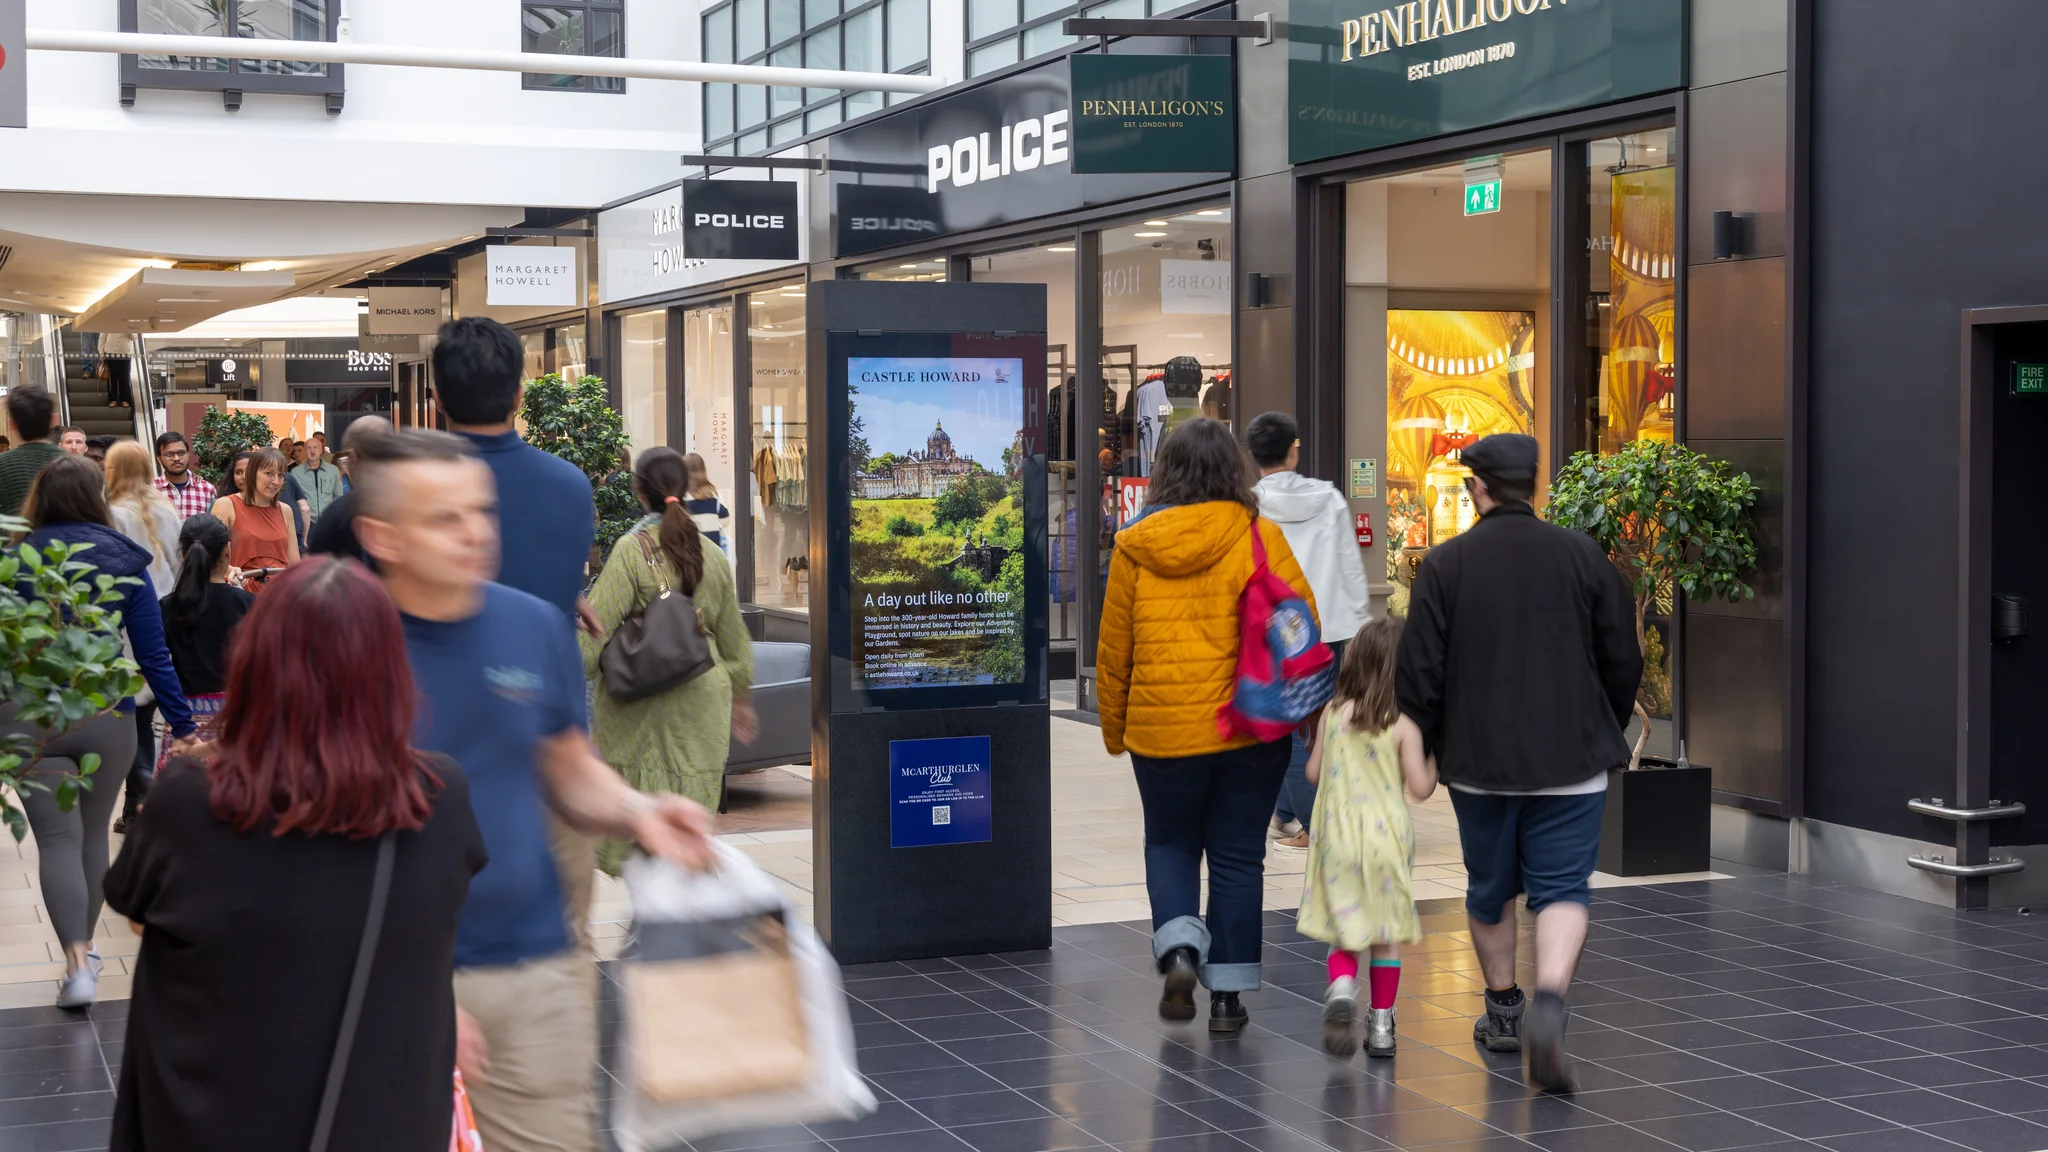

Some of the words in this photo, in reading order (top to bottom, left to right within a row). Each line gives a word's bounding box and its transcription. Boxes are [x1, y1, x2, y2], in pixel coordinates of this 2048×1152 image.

[1407, 61, 1432, 81] EST.
[1433, 48, 1485, 75] LONDON
[1486, 41, 1515, 62] 1870
[1082, 100, 1224, 116] PENHALIGON'S
[928, 109, 1068, 194] POLICE
[694, 213, 785, 229] POLICE
[495, 266, 568, 274] MARGARET
[495, 277, 551, 286] HOWELL
[348, 350, 392, 366] BOSS
[222, 373, 236, 382] Lift
[861, 372, 916, 382] CASTLE
[920, 372, 981, 382] HOWARD
[2021, 366, 2044, 378] FIRE
[2021, 378, 2044, 389] EXIT
[864, 593, 875, 607] A
[877, 592, 902, 610] day
[904, 592, 926, 606] out
[930, 590, 953, 604] like
[956, 593, 972, 604] no
[976, 590, 1011, 603] other
[864, 616, 878, 624] Step
[902, 614, 938, 622] 300-year-old
[938, 612, 960, 620] Howard
[961, 612, 978, 620] family
[900, 622, 920, 630] history
[932, 621, 952, 629] beauty.
[864, 632, 898, 640] Playground,
[984, 628, 1006, 636] inspired
[1007, 626, 1014, 634] by
[930, 771, 952, 784] Club
